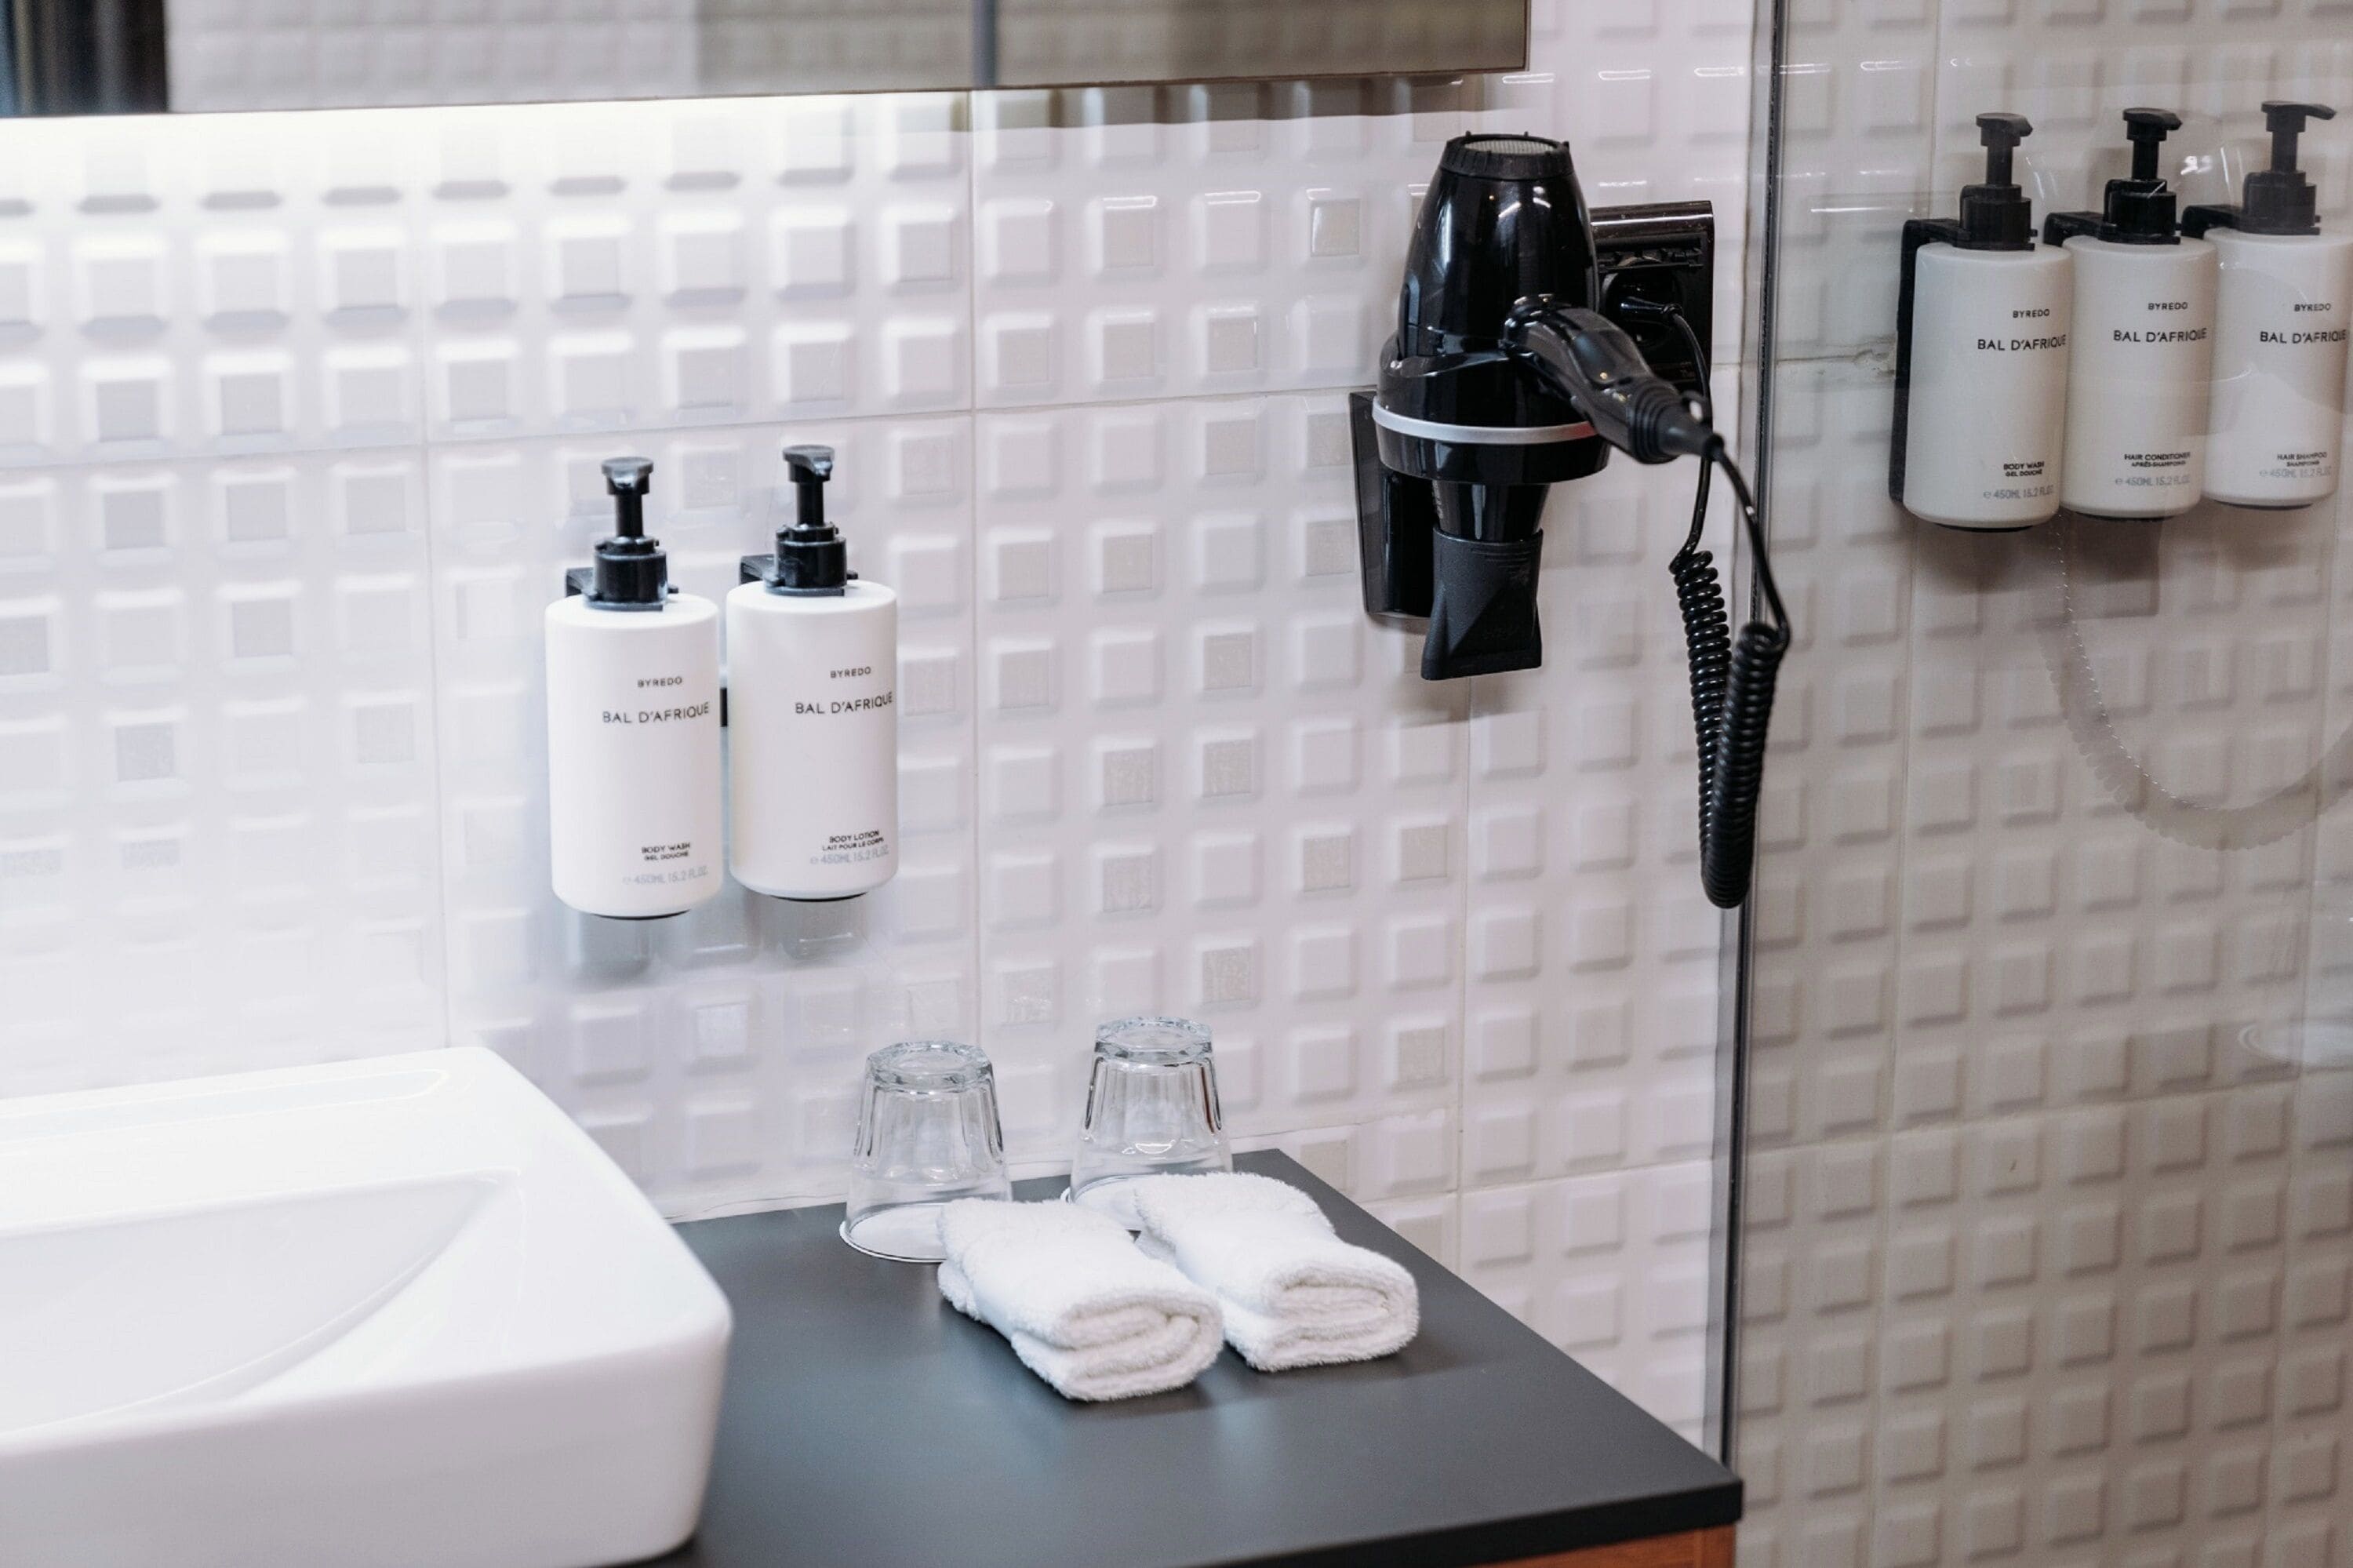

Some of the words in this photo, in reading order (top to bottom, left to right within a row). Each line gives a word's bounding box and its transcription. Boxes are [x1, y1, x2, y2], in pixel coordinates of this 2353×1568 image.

[2148, 301, 2188, 311] BYREDO
[2294, 303, 2332, 312] BYREDO
[2013, 308, 2050, 318] BYREDO
[2113, 329, 2140, 342] BAL
[2260, 332, 2287, 344] BAL
[1977, 339, 2005, 351] BAL
[2011, 335, 2067, 351] D'AFRIQUE
[2144, 452, 2191, 460] CONDITIONER
[830, 666, 871, 678] BYREDO
[638, 676, 682, 688] BYREDO
[795, 703, 825, 714] BAL
[831, 691, 893, 714] D'AFRIQUE
[602, 711, 632, 723] BAL
[638, 702, 710, 723] D'AFRIQUE
[854, 830, 880, 841] LOTION
[668, 842, 690, 850] WASH
